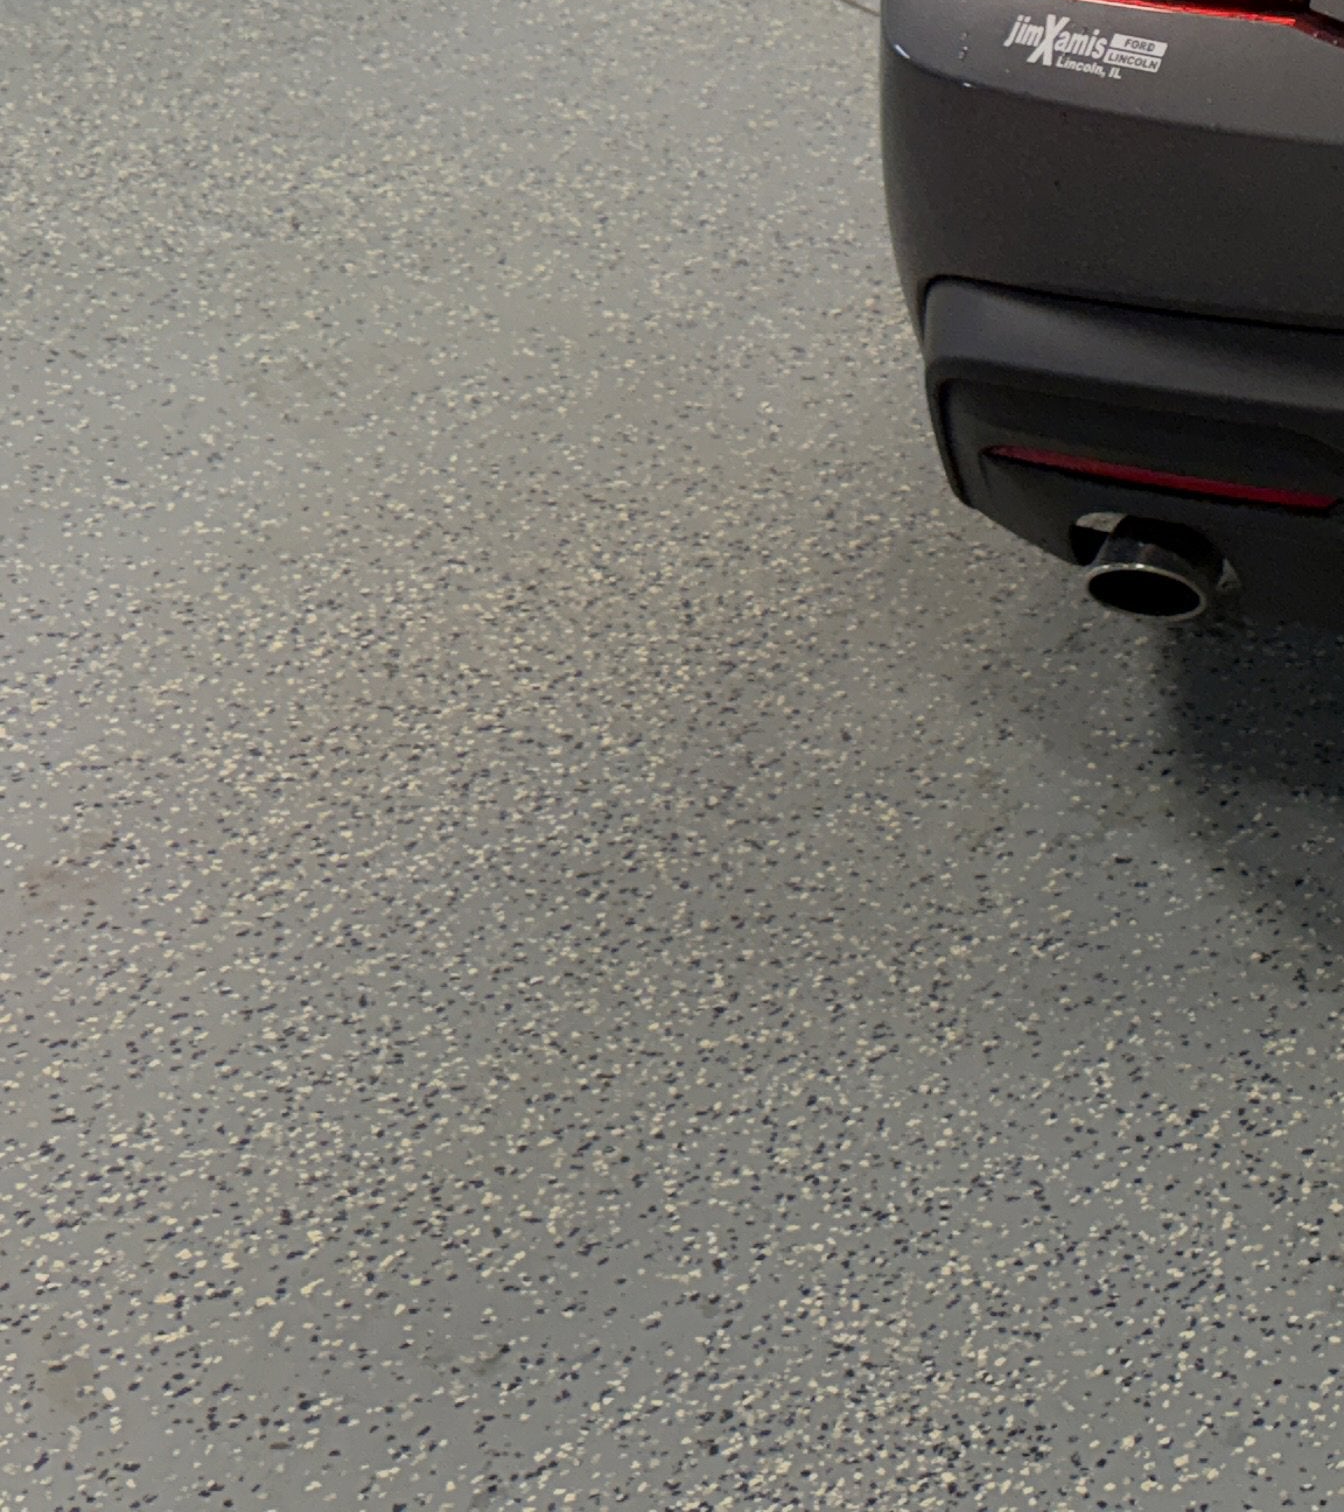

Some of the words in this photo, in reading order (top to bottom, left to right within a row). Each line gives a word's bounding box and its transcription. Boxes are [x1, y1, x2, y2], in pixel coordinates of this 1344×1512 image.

[1124, 38, 1156, 52] FORD
[1055, 55, 1106, 78] Lincoln,
[1108, 66, 1122, 79] IL
[1107, 49, 1158, 71] LINCOLN
